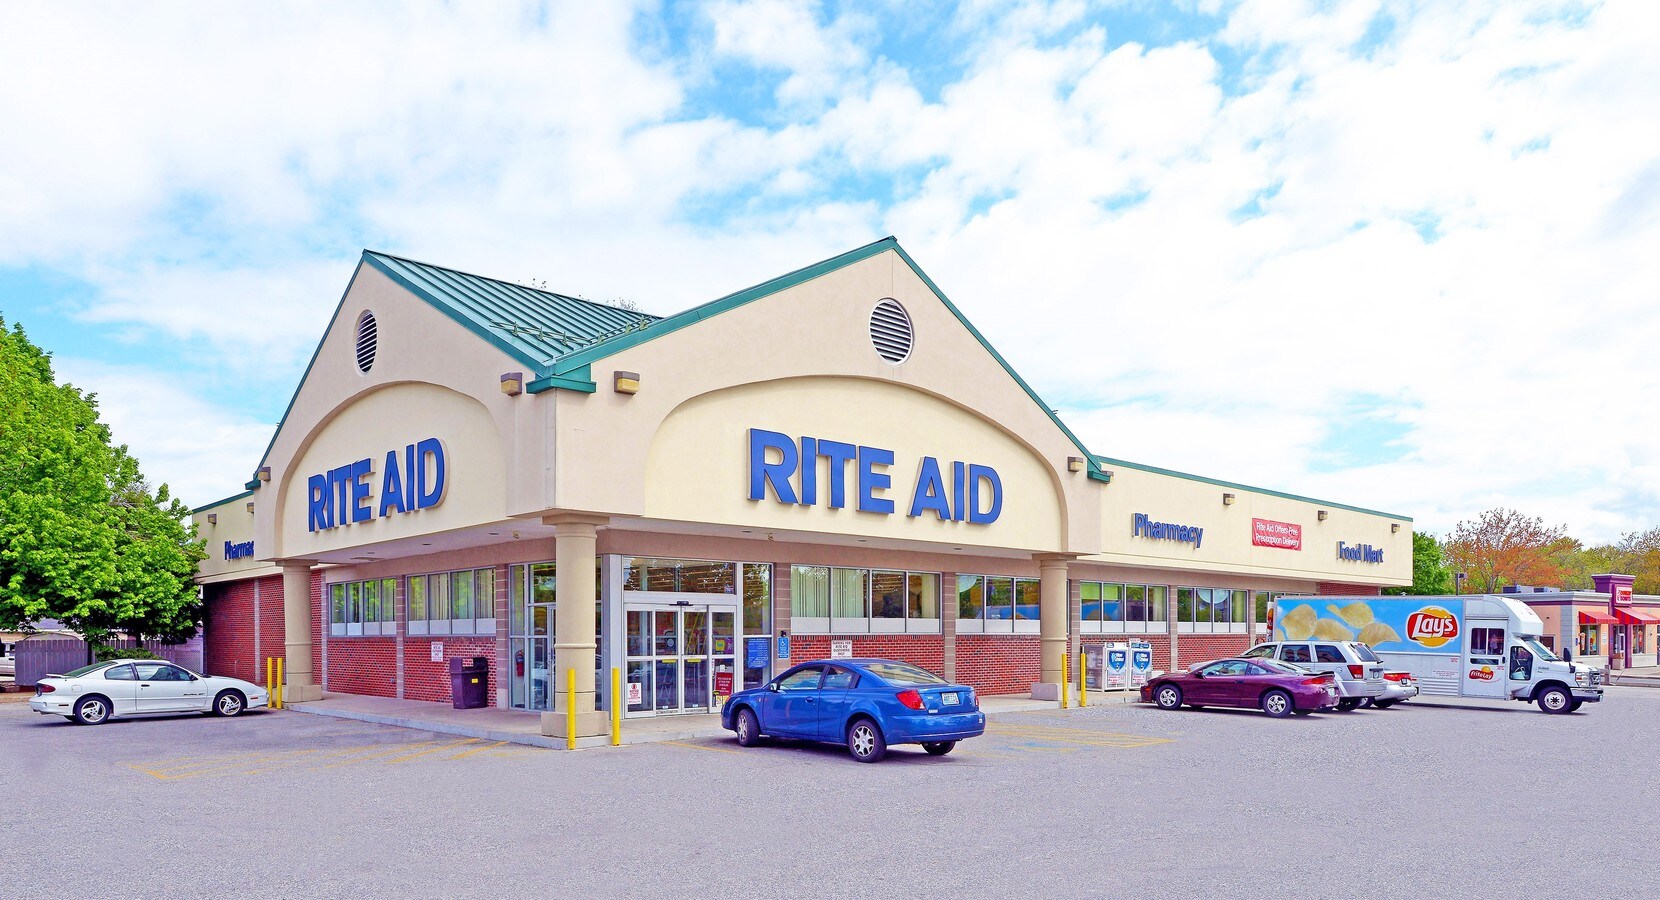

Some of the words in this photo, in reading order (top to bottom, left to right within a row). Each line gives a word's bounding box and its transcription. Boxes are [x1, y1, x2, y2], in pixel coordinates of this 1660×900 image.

[308, 457, 373, 532] RITE
[379, 437, 447, 518] AID
[747, 427, 895, 515] RITE
[907, 455, 1003, 524] AID
[1132, 512, 1204, 549] Pharmacy
[1255, 532, 1282, 545] Prescription
[1256, 521, 1266, 532] Rite
[1266, 523, 1274, 533] Aid
[1338, 541, 1361, 561] Food
[1363, 543, 1384, 563] Mart
[1412, 614, 1454, 638] Lay's
